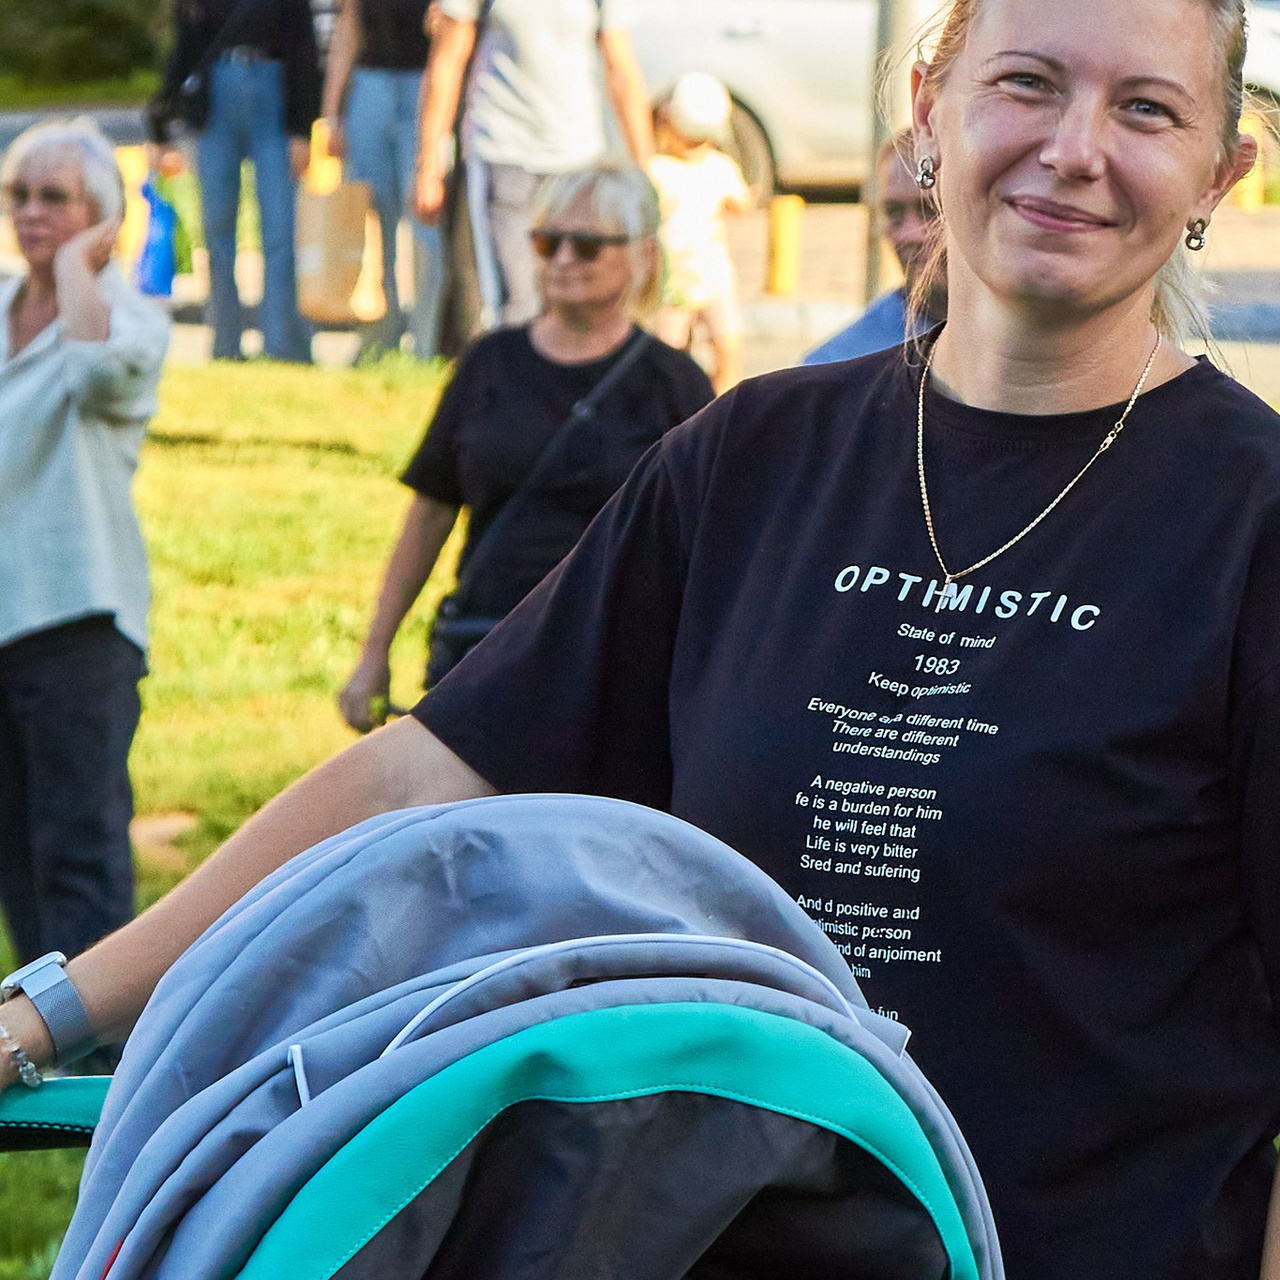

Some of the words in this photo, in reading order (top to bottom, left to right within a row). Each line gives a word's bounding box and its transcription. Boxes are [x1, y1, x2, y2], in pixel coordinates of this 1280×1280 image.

[833, 565, 1100, 630] OPTIMISTIC
[897, 623, 935, 642] State
[939, 631, 955, 645] of
[960, 633, 997, 649] mind
[914, 654, 960, 676] 1983
[868, 671, 909, 698] Keep
[911, 682, 972, 700] optimistic
[807, 697, 877, 720] Everyone
[906, 713, 964, 730] different
[966, 718, 999, 735] time
[832, 720, 872, 737] There
[874, 727, 899, 740] are
[901, 730, 960, 747] different
[832, 741, 941, 766] understandings
[810, 774, 822, 789] A
[824, 778, 885, 796] negative
[887, 786, 937, 800] person
[812, 794, 825, 809] is
[828, 800, 838, 811] a
[841, 798, 890, 816] burden
[893, 803, 914, 818] for
[915, 805, 943, 820] him
[813, 815, 831, 830] he
[835, 819, 858, 834] will
[861, 820, 887, 836] feel
[889, 823, 917, 839] that
[806, 834, 831, 851] Life
[834, 838, 846, 853] is
[850, 843, 880, 859] very
[883, 843, 918, 859] bitter
[800, 854, 832, 871] Sred
[834, 861, 862, 875] and
[864, 864, 921, 884] sufering
[797, 894, 822, 911] And
[836, 902, 889, 918] positive
[893, 906, 920, 920] and
[862, 926, 912, 940] person
[853, 943, 866, 957] of
[868, 946, 942, 963] anjoiment
[851, 963, 871, 979] him
